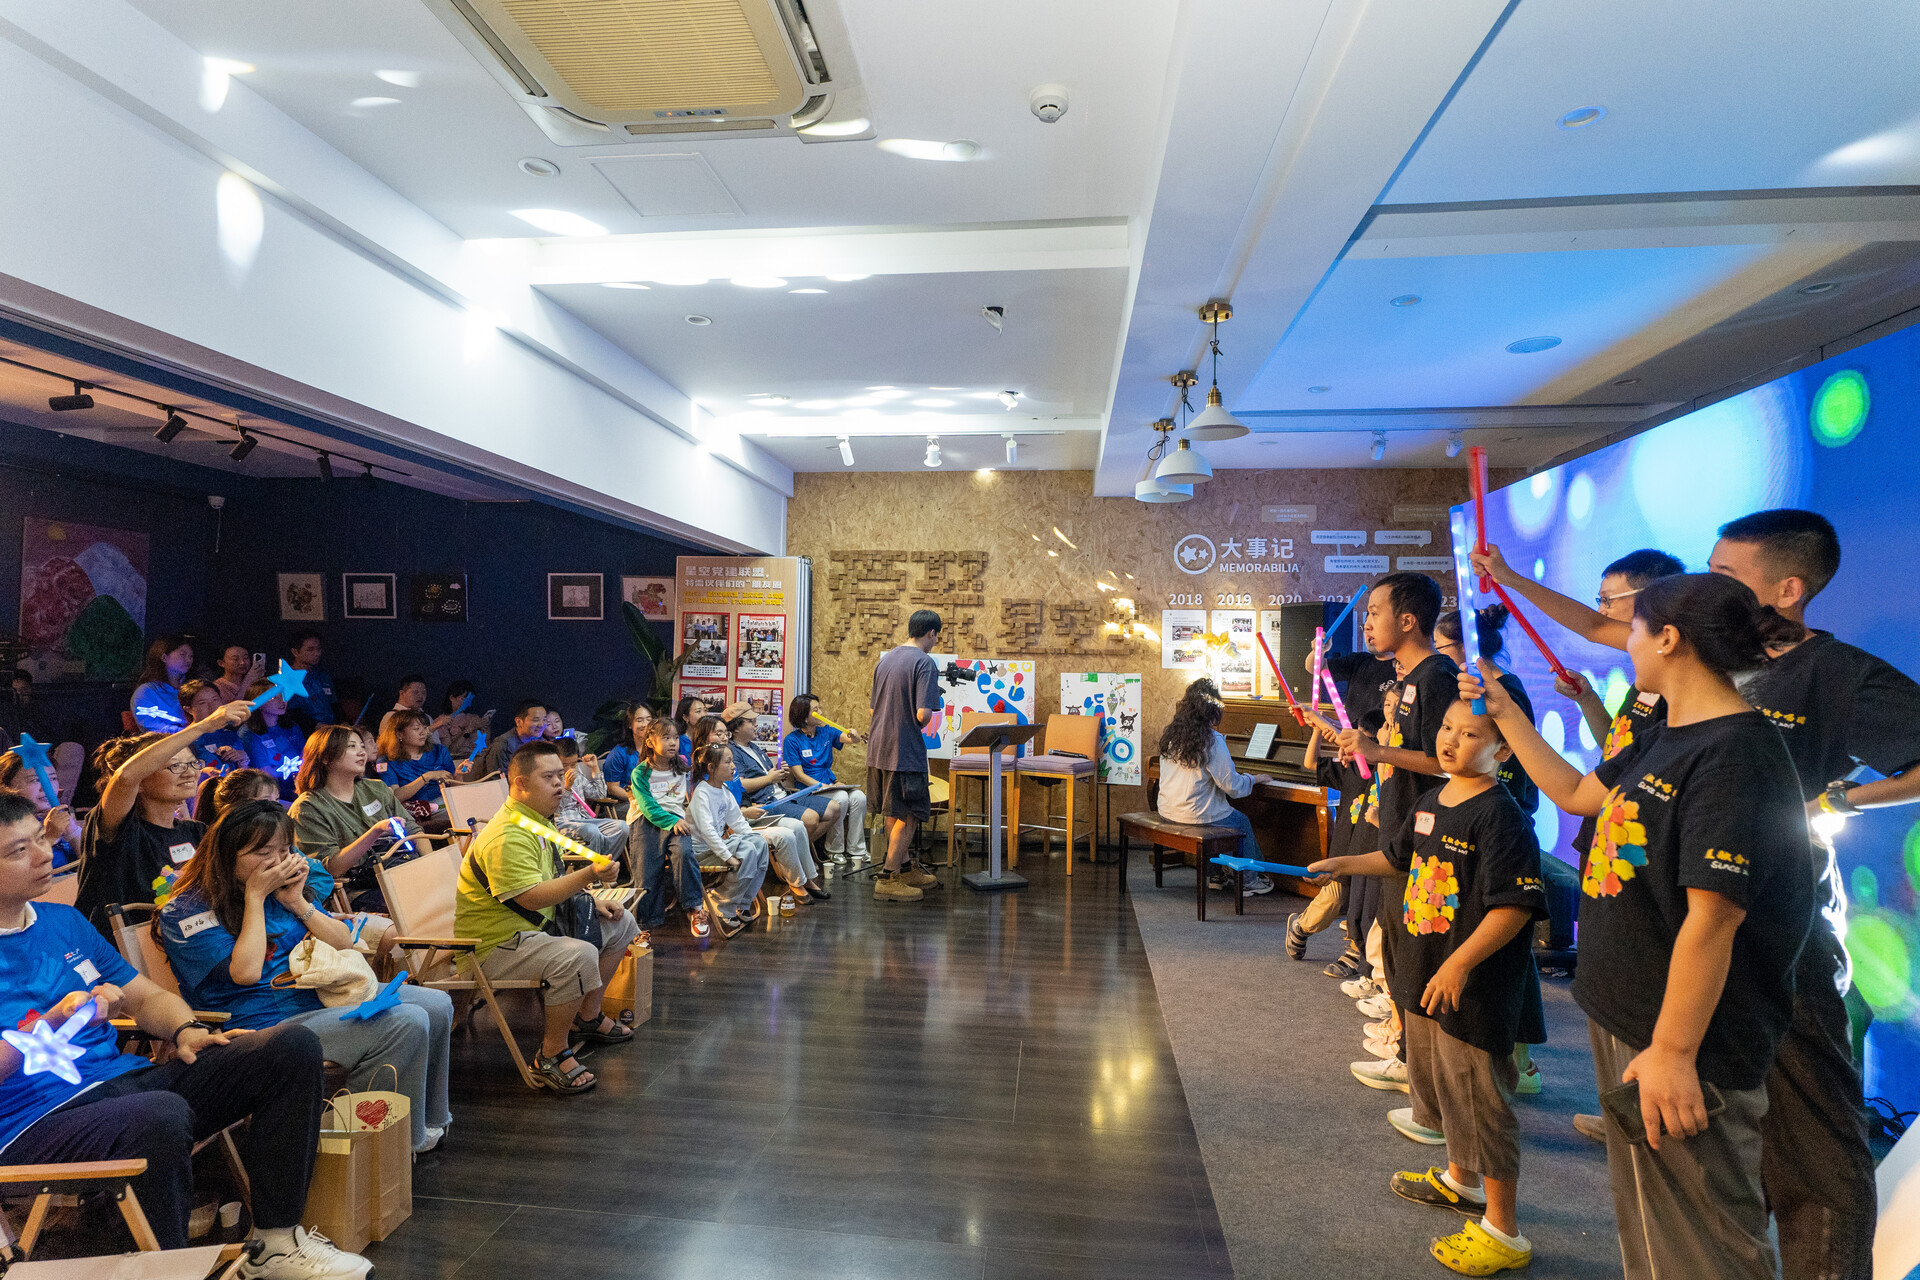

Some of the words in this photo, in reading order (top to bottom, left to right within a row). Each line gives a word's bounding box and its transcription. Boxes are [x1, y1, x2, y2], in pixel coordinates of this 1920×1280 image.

[1220, 537, 1294, 559] 大事记
[1219, 562, 1300, 573] MEMORABILIA
[1168, 593, 1203, 606] 2018
[1217, 593, 1252, 606] 2019
[1268, 594, 1302, 606] 2020
[1440, 595, 1458, 608] 23
[1710, 860, 1742, 874] Since
